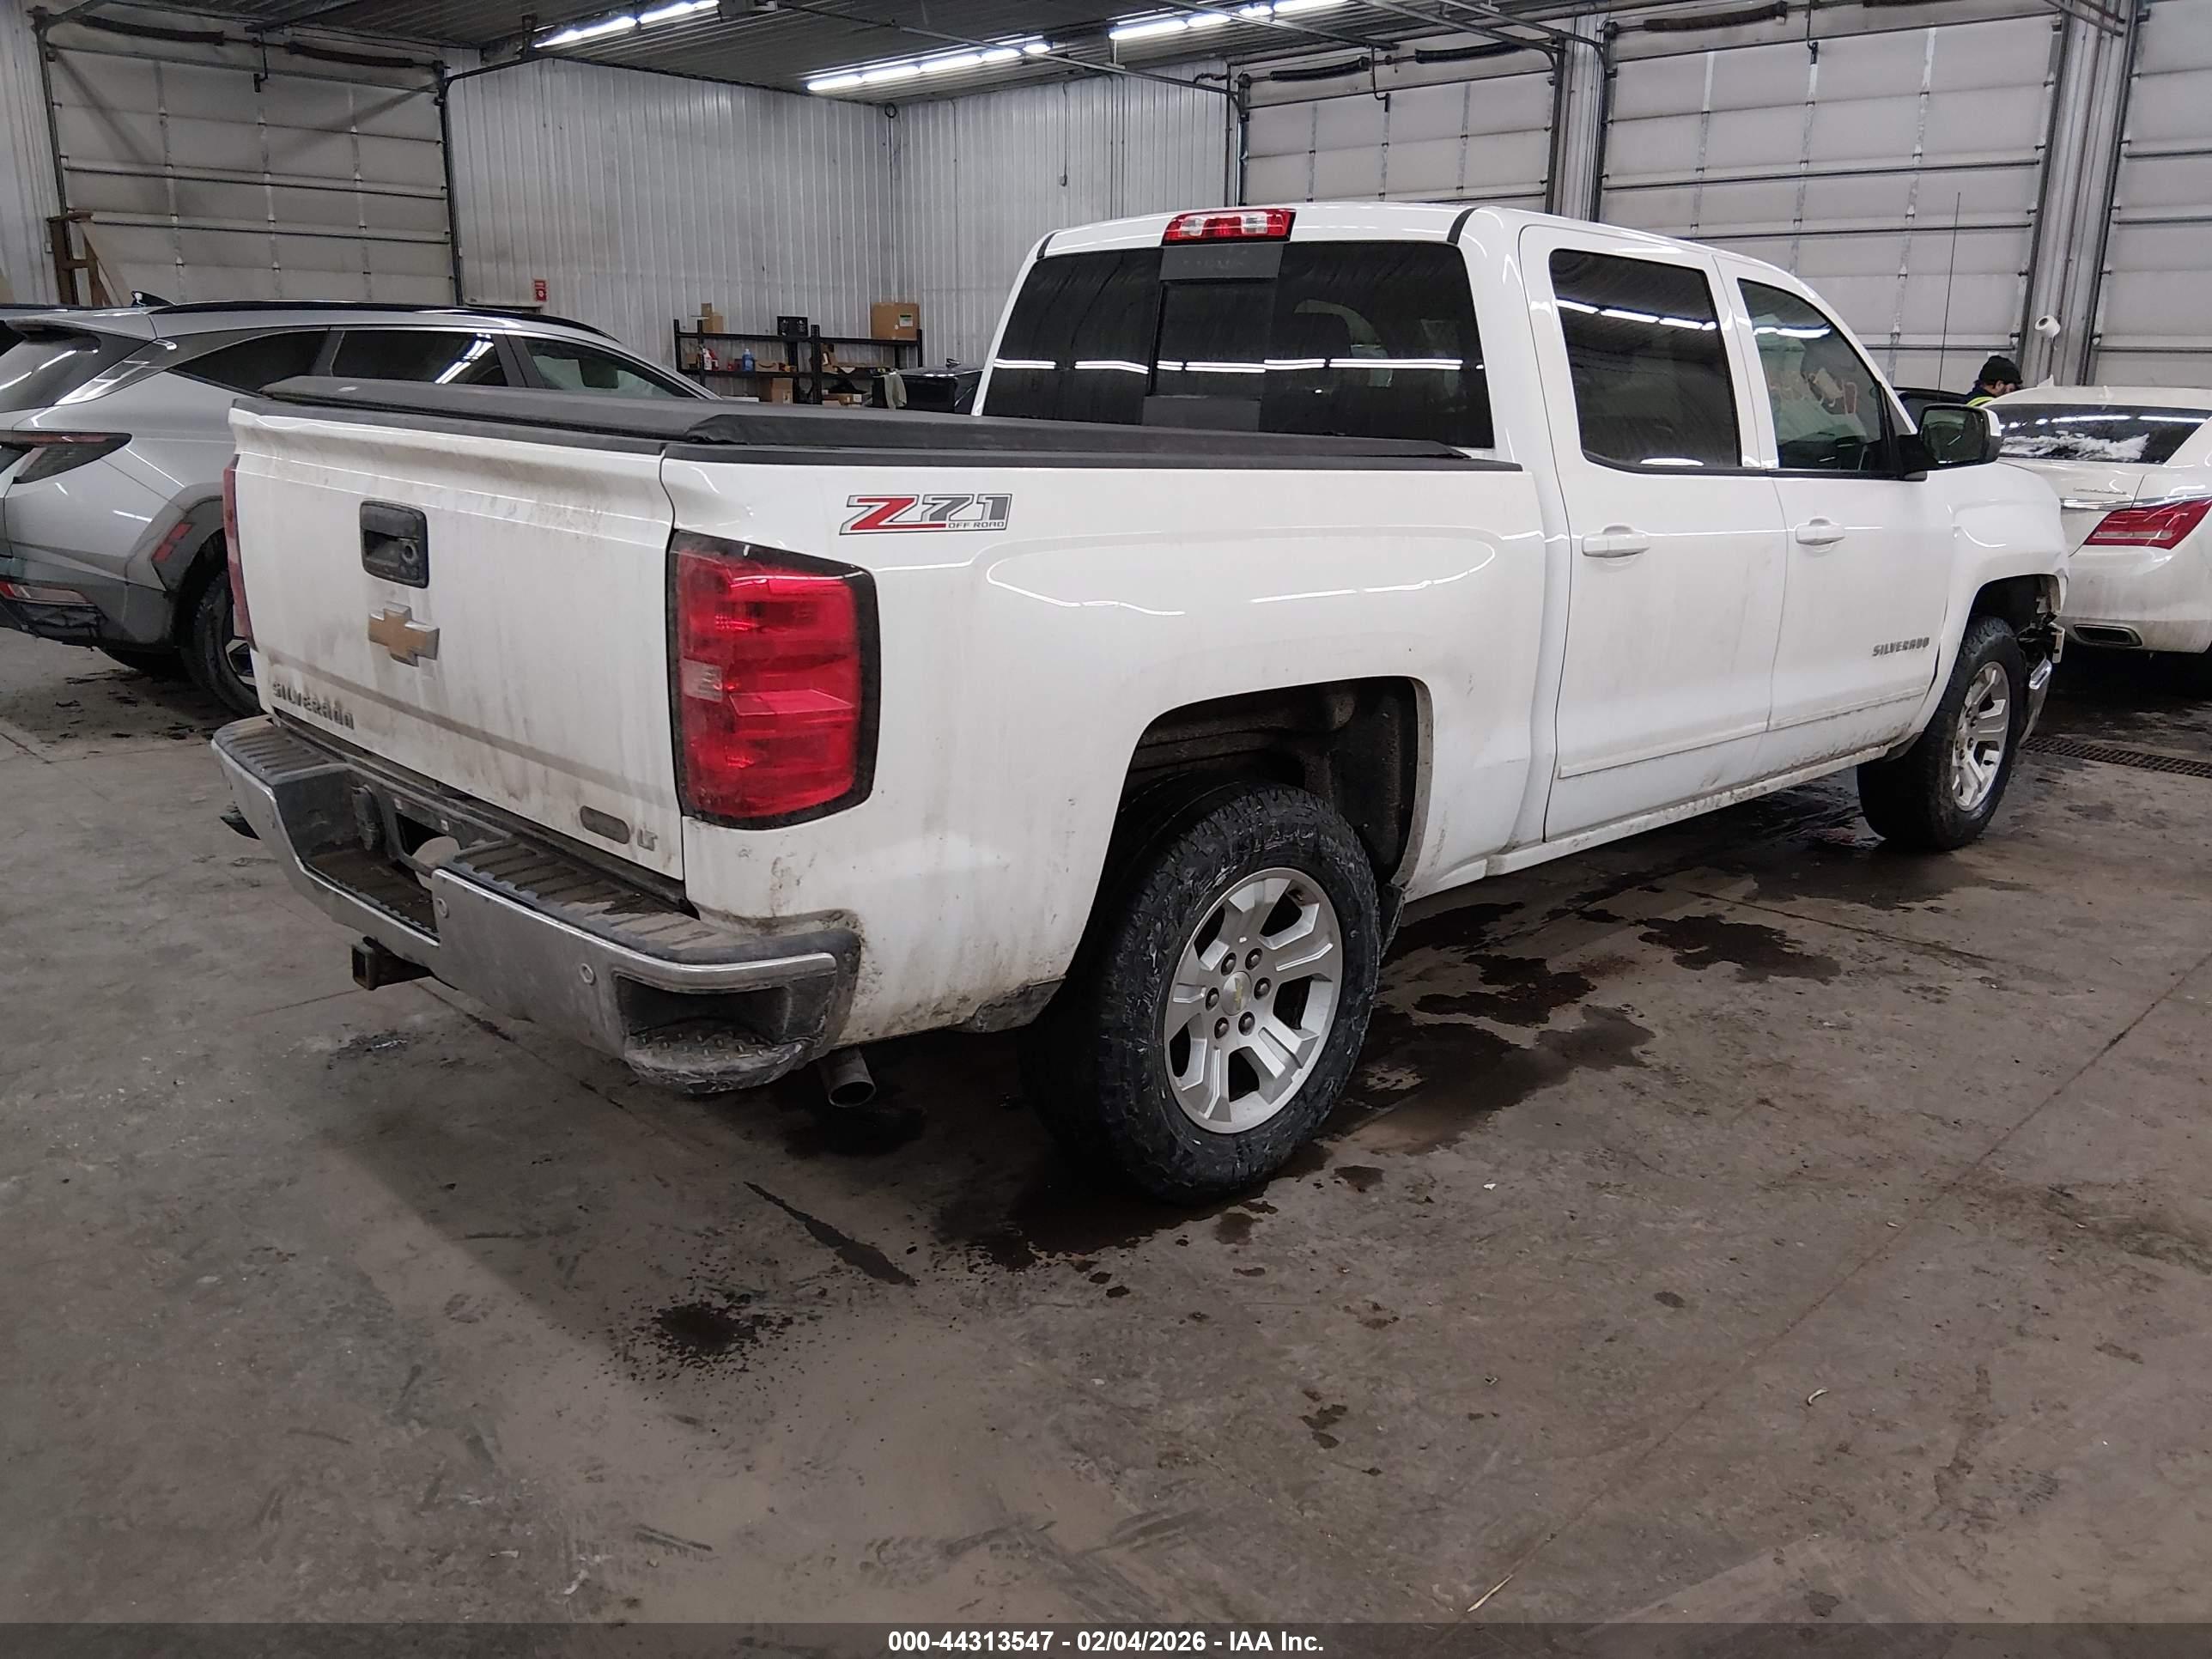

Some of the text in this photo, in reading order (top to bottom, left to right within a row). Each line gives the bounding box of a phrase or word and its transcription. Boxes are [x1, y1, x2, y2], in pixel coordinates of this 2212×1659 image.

[840, 494, 1012, 536] Z71
[1872, 636, 1930, 657] SILVERADO
[273, 682, 355, 731] SILVERADO
[636, 828, 659, 852] LT
